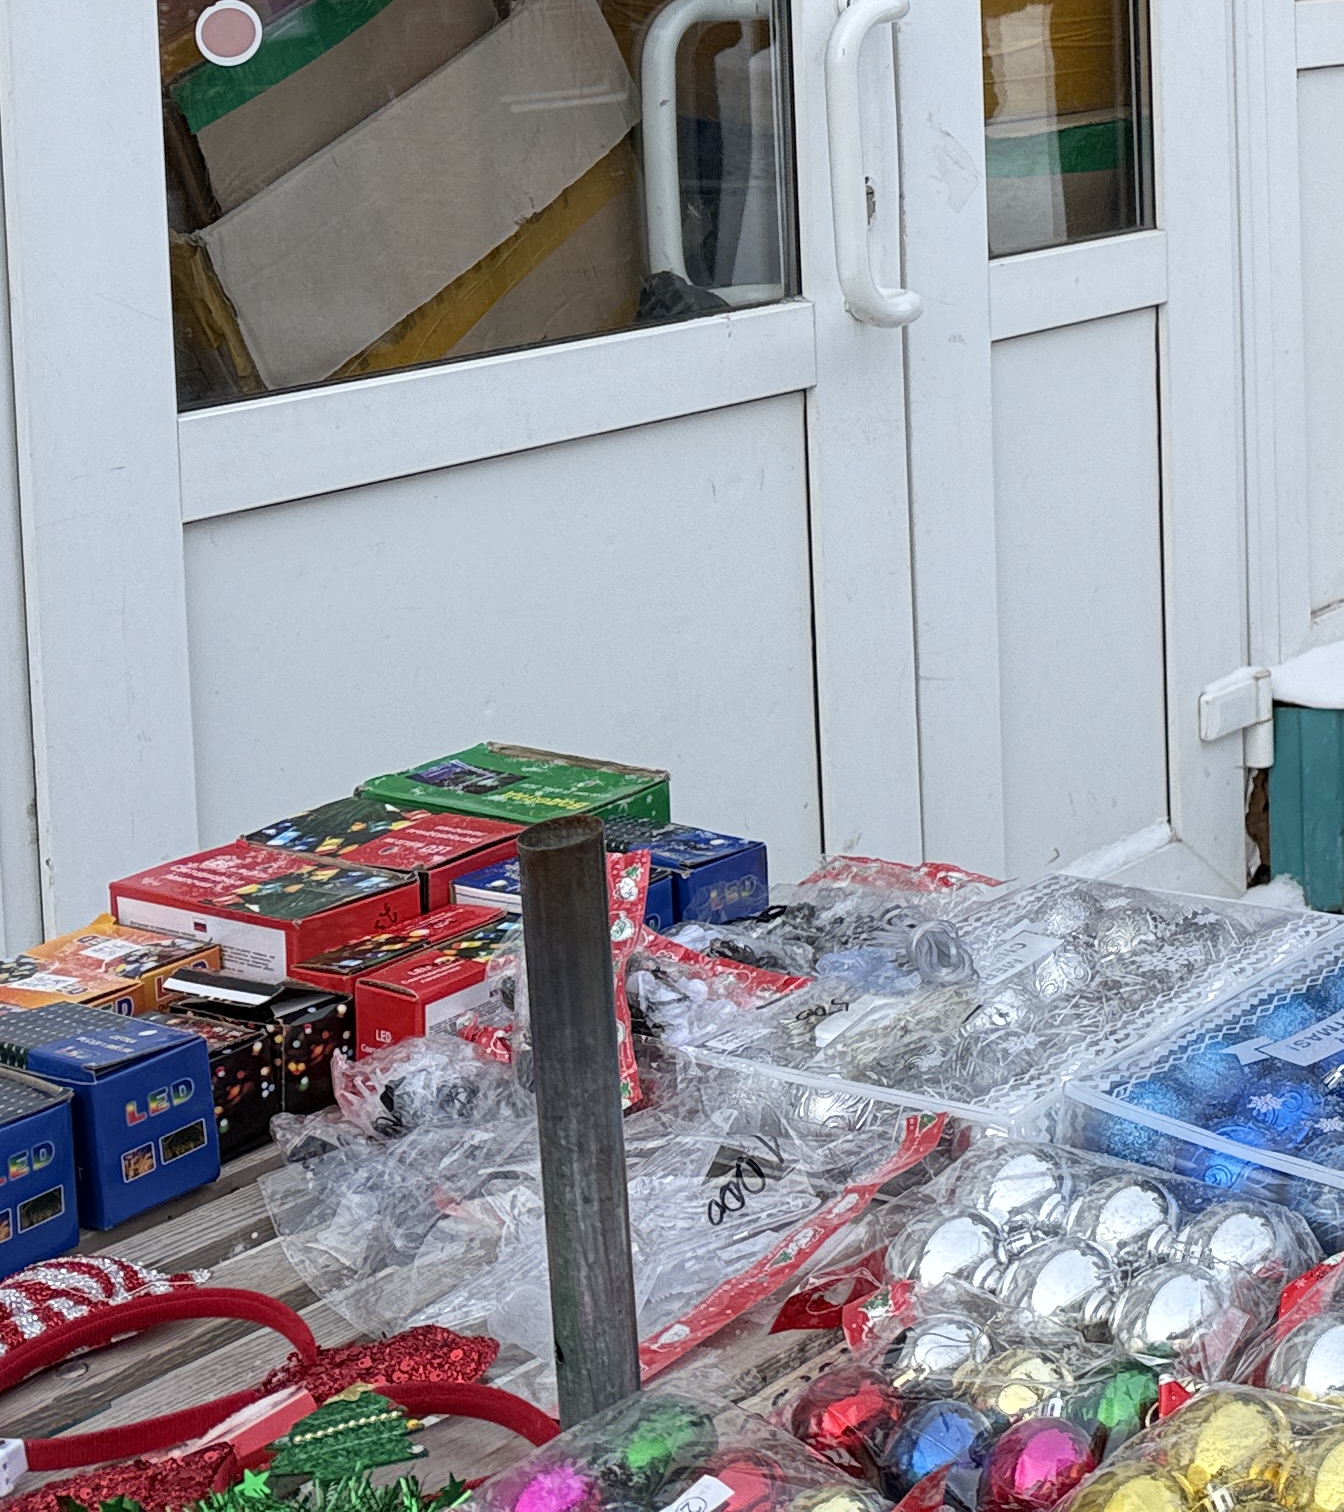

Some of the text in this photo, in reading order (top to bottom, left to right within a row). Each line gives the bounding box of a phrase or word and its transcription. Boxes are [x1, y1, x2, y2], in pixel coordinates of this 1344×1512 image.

[708, 874, 757, 911] LED
[375, 1029, 392, 1044] LED
[125, 1076, 195, 1127] LED
